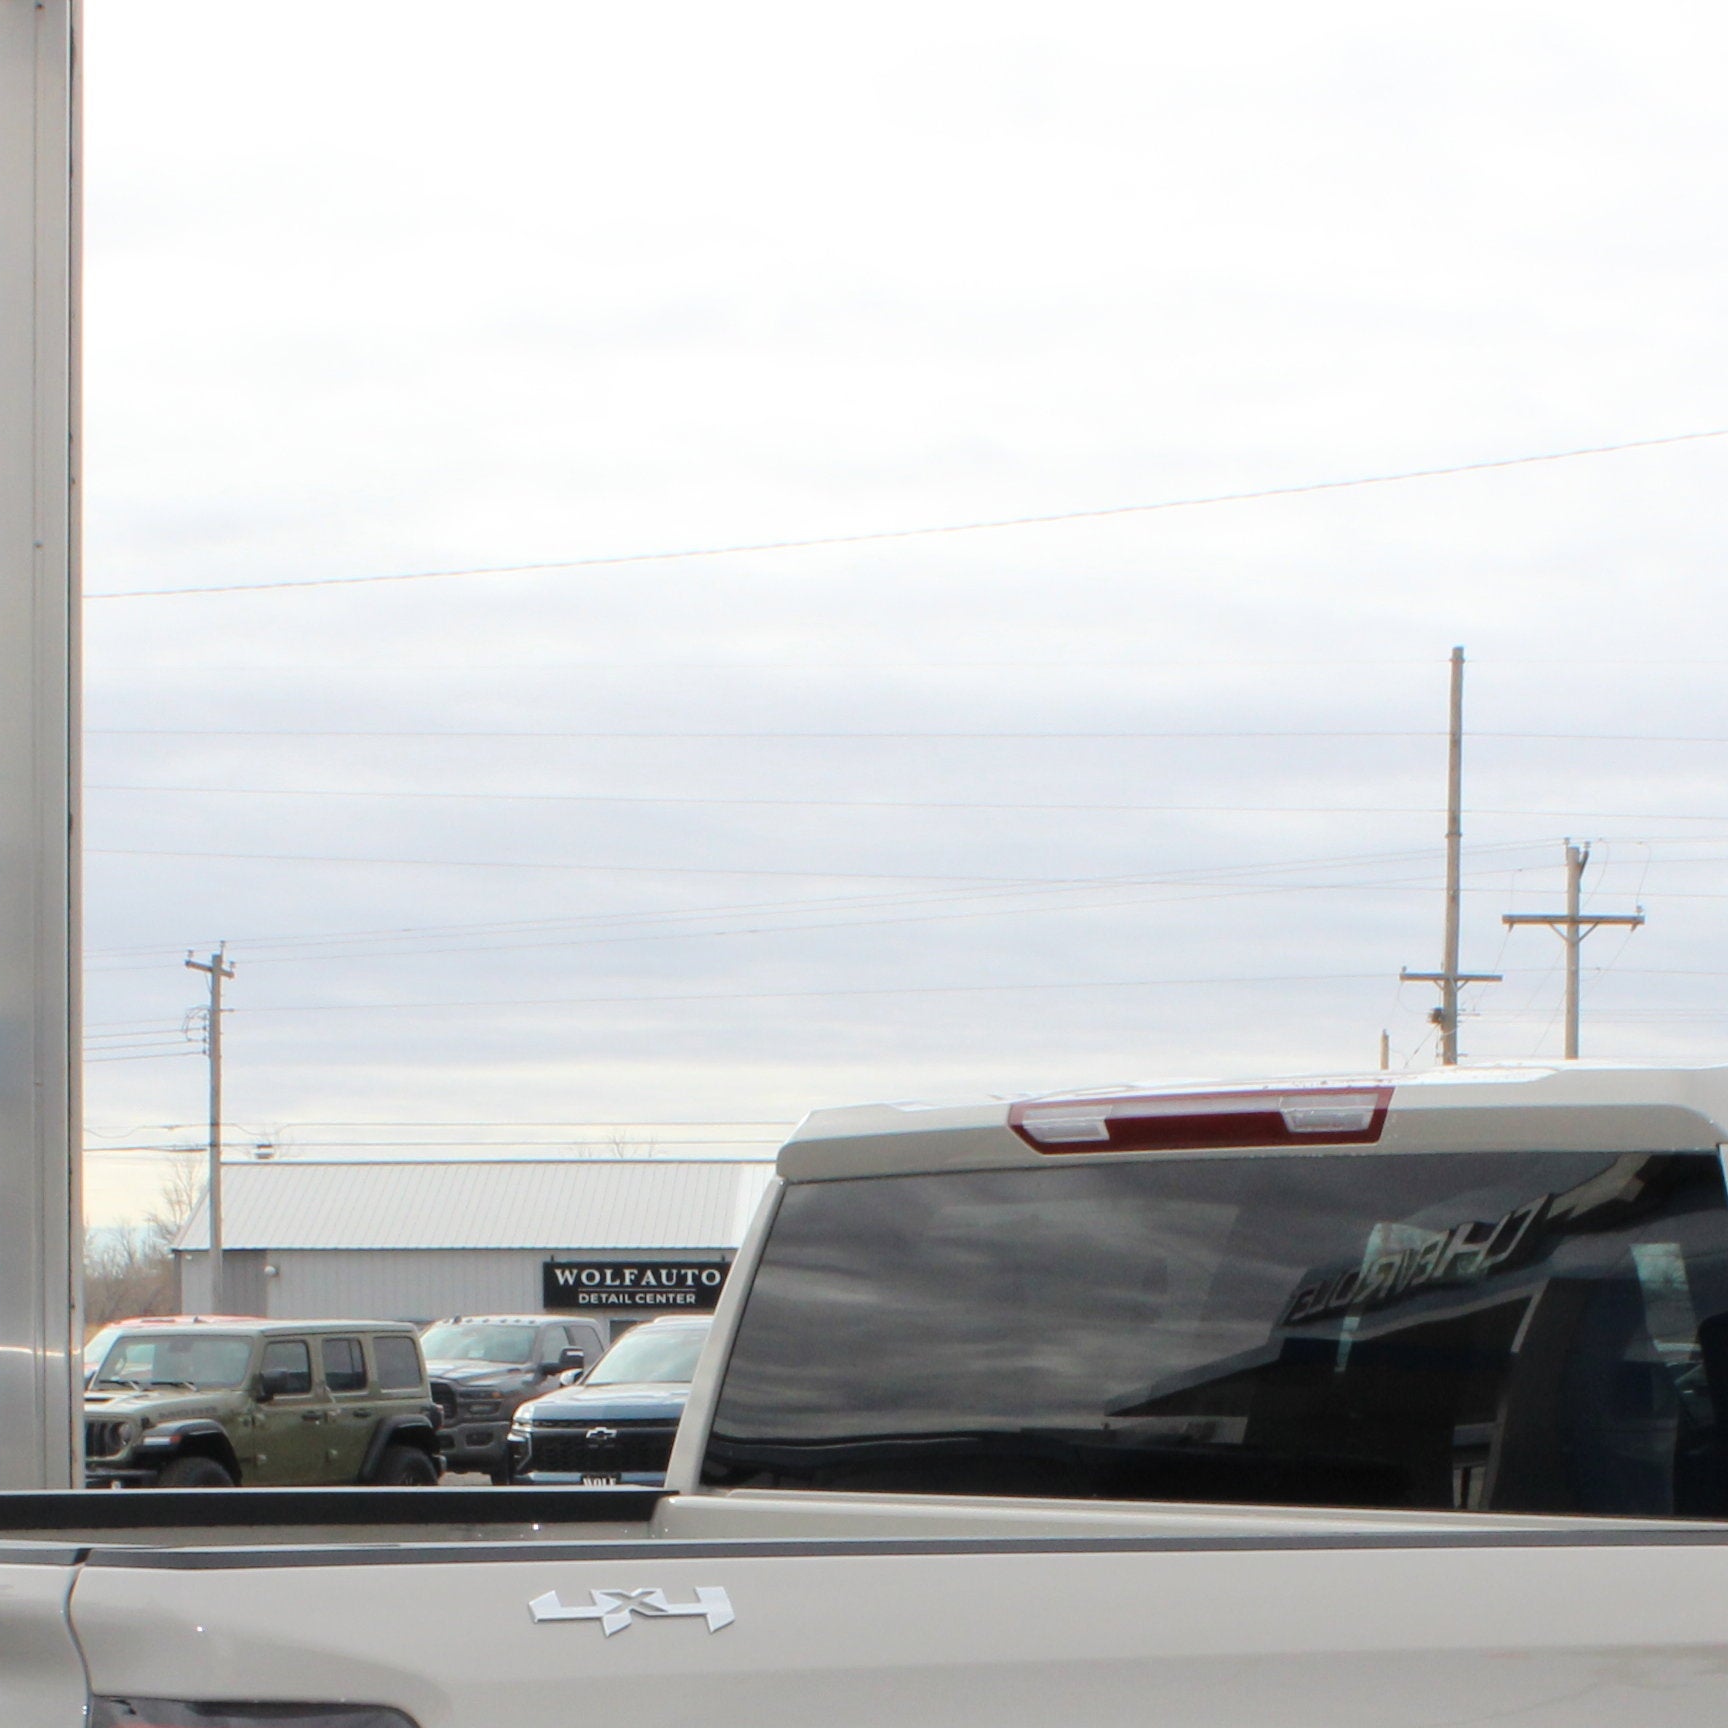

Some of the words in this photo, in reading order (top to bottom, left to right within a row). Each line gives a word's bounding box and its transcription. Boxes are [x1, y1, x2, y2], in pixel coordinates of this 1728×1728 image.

[554, 1268, 721, 1286] WOLFAUTO
[578, 1293, 632, 1304] DETAIL
[635, 1293, 696, 1304] CENTER
